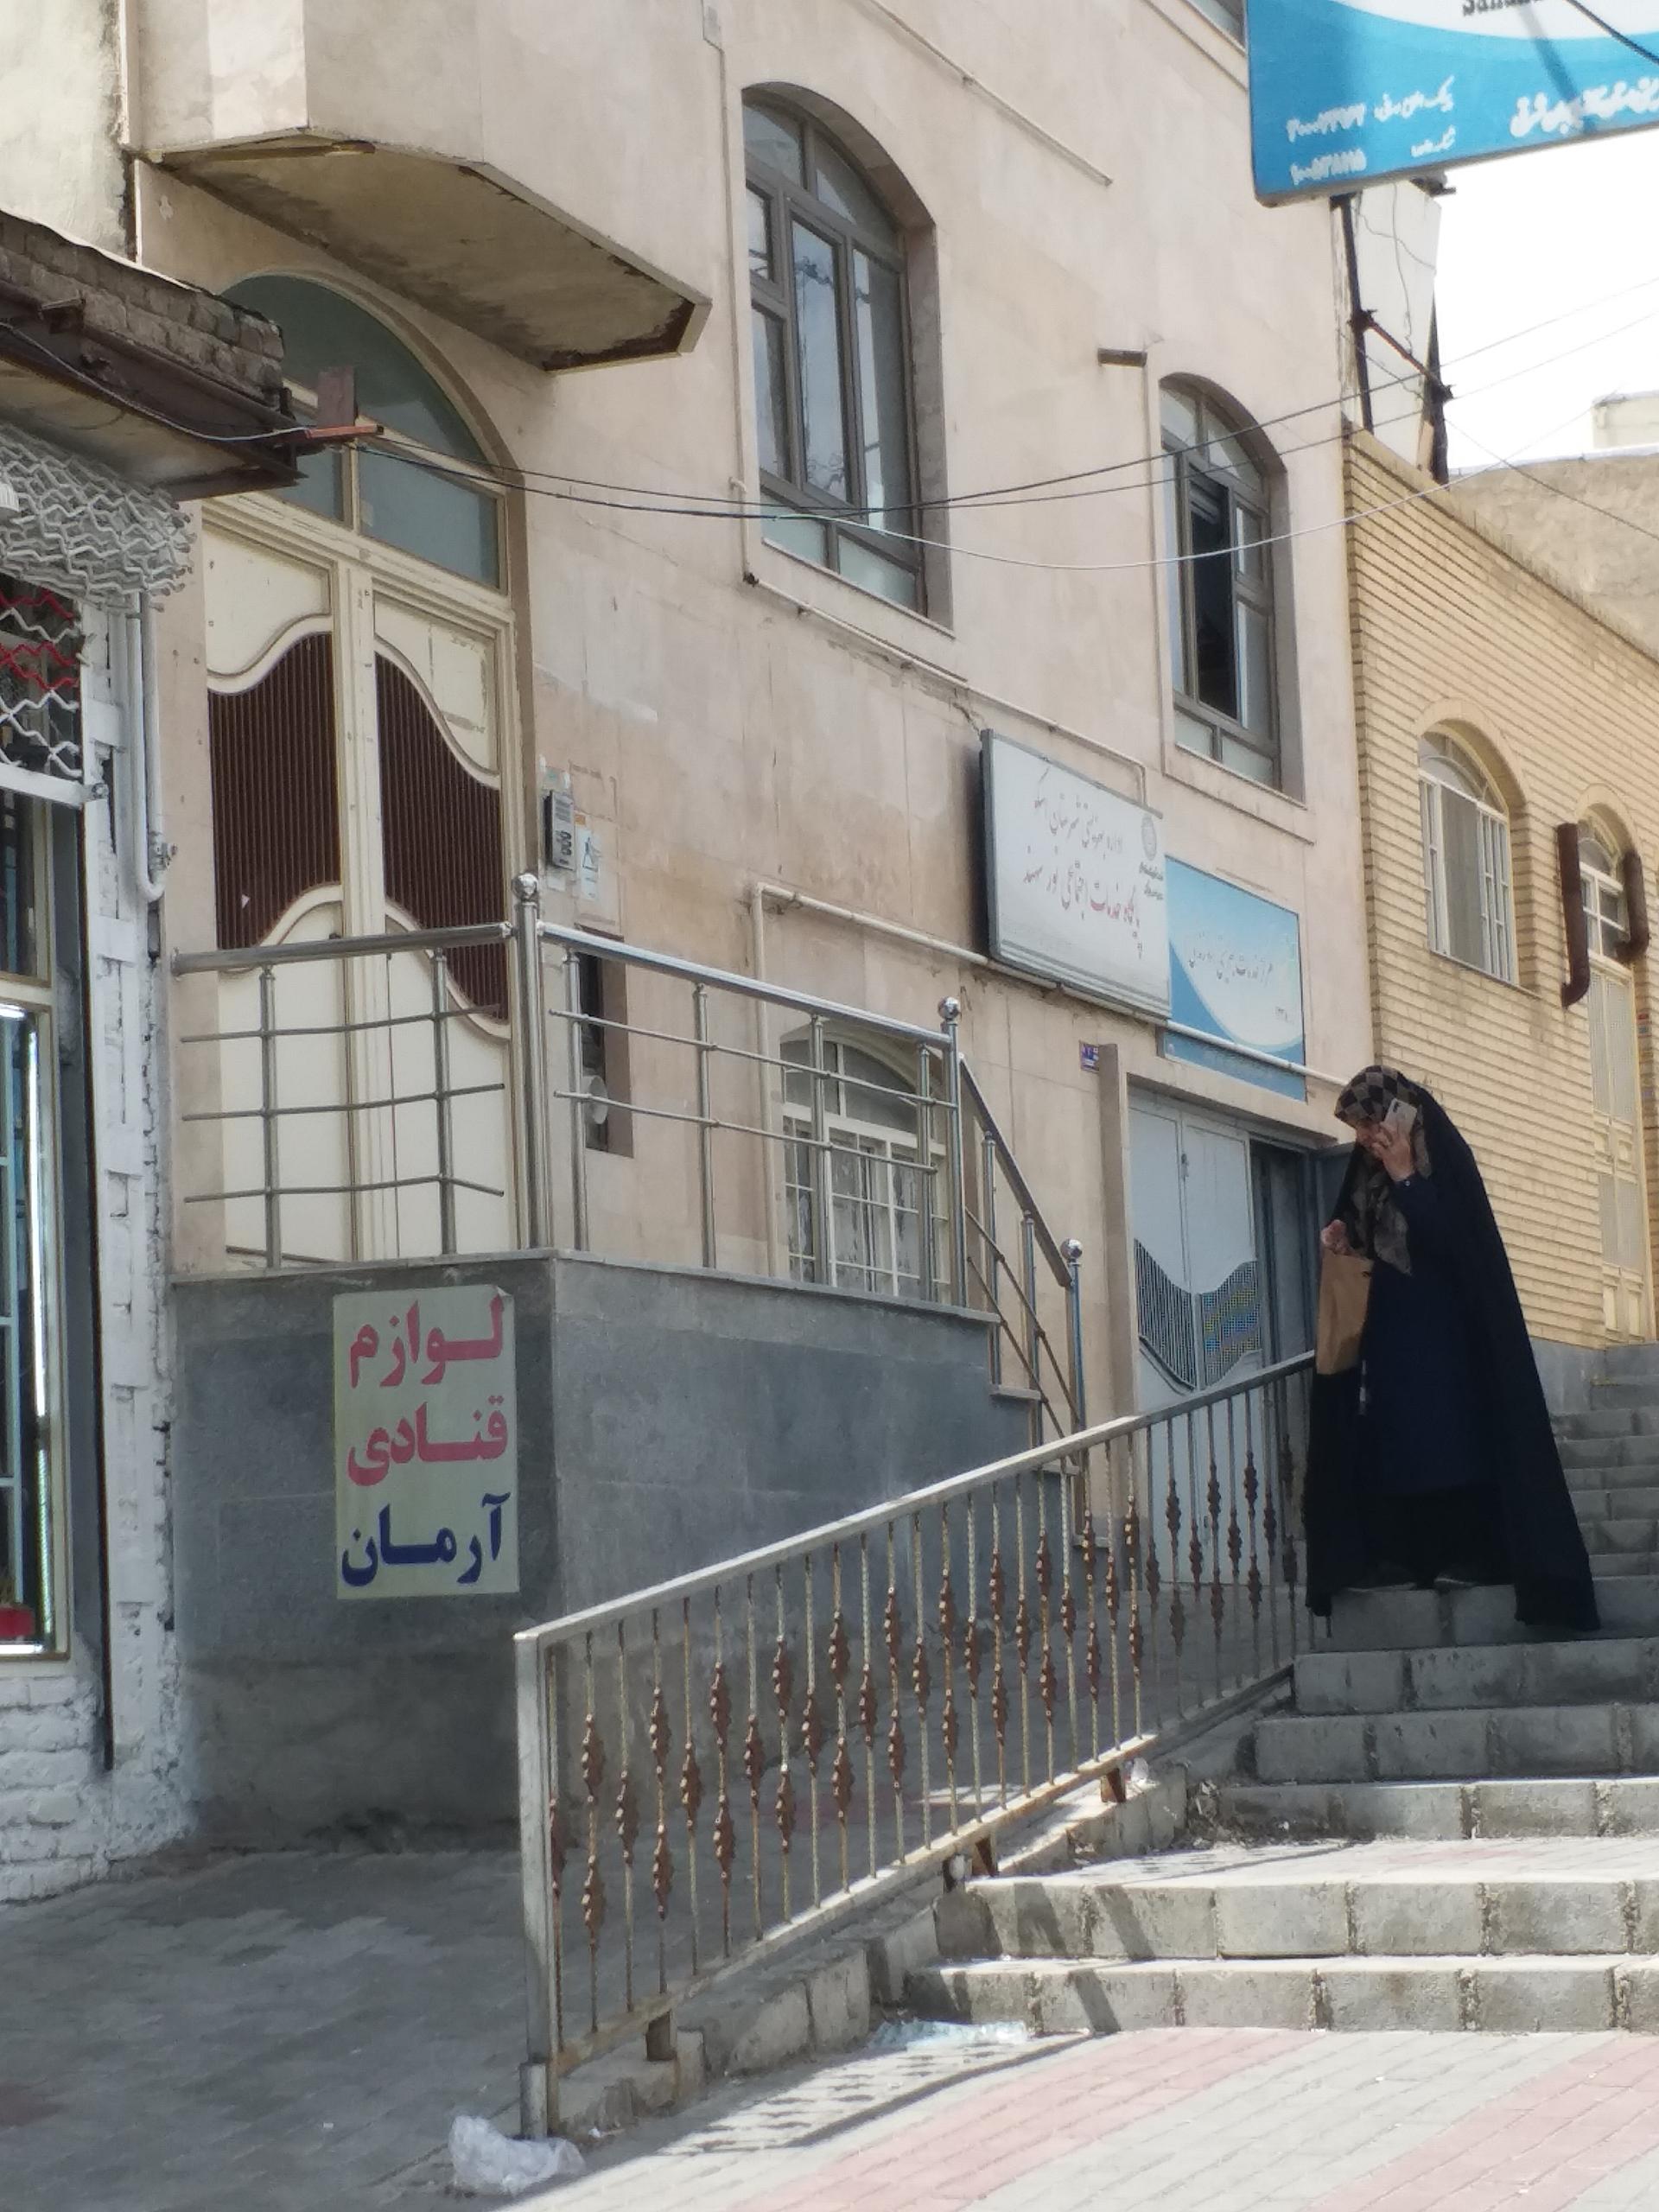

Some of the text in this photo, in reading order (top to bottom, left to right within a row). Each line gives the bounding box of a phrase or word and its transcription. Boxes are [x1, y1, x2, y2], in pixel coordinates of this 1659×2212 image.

[1090, 880, 1122, 919] خدمات
[348, 1294, 505, 1389] لوازم
[347, 1395, 508, 1487] قنادی
[341, 1491, 512, 1587] آرمان
